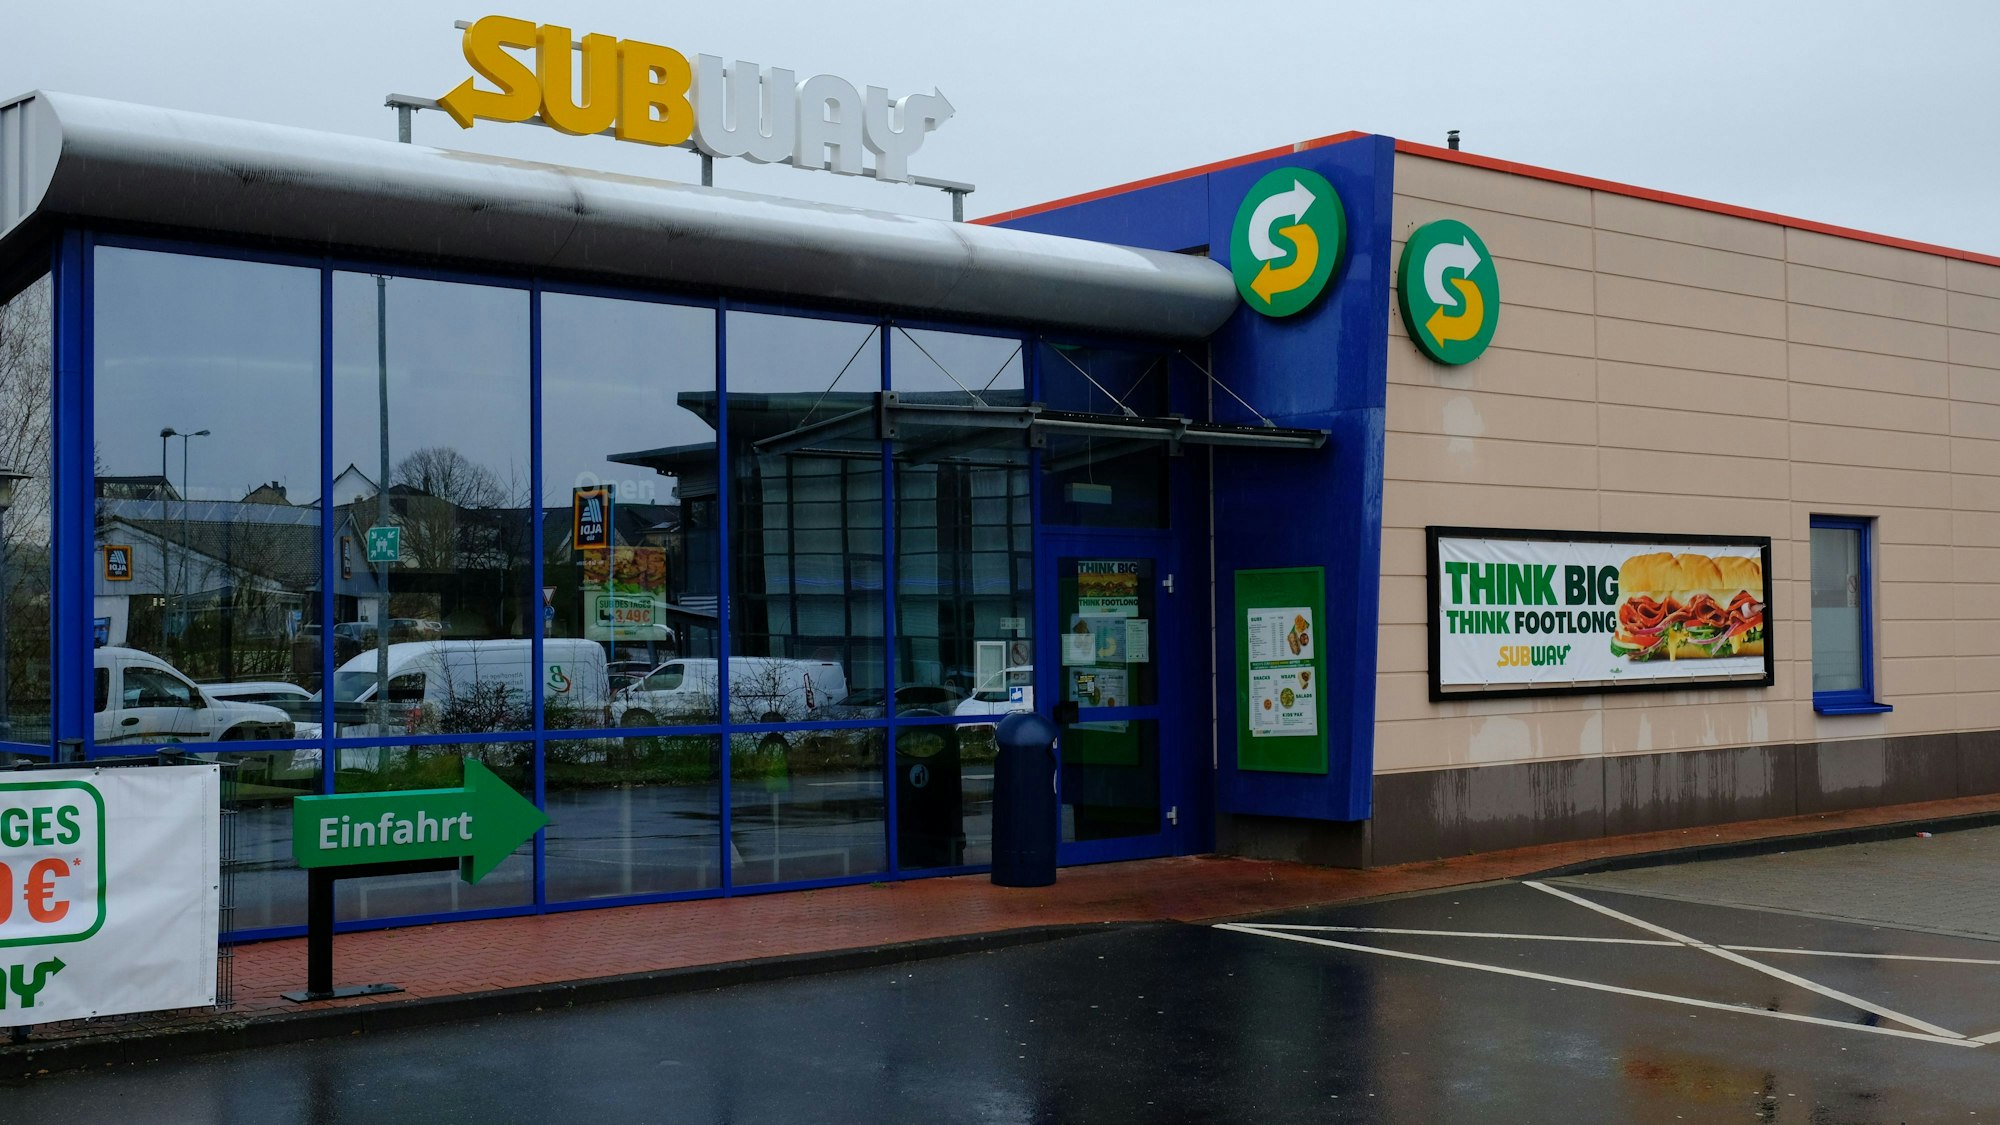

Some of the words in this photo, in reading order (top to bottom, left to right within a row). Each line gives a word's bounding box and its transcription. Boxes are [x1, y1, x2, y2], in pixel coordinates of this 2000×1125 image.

[437, 15, 955, 182] SUBWAY
[575, 471, 655, 505] Open
[1079, 562, 1115, 573] THINK
[1117, 563, 1138, 573] BIG
[1445, 561, 1558, 606] THINK
[1564, 565, 1620, 606] BIG
[1446, 610, 1511, 634] THINK
[1514, 611, 1617, 634] FOOTLONG
[1497, 644, 1571, 667] SUBWAY
[319, 810, 473, 850] Einfahrt
